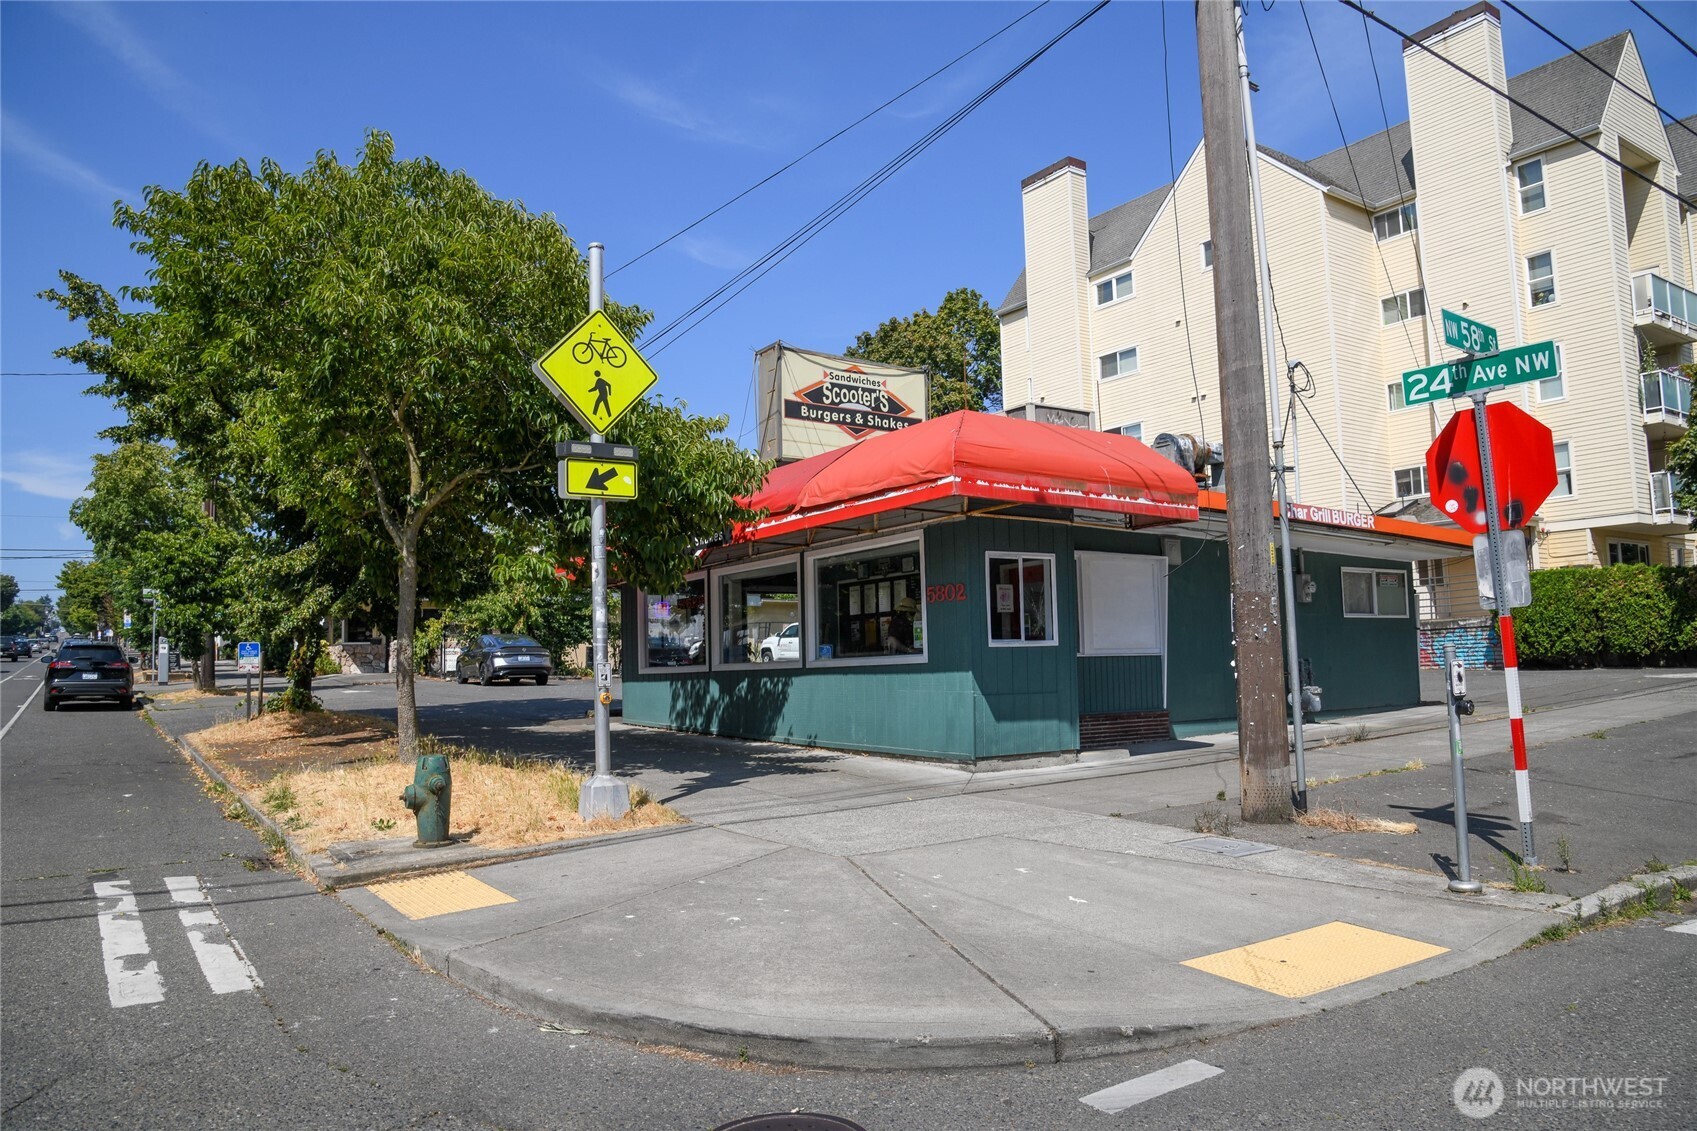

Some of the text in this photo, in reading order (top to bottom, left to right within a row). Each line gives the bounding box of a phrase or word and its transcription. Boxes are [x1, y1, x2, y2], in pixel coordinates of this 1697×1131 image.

[1445, 319, 1496, 351] NW 58th St
[828, 371, 881, 388] Sandwiches
[1407, 350, 1549, 401] 24th Ave NW
[801, 405, 909, 430] Burgers & Shakes
[1310, 507, 1332, 523] Grill
[1332, 509, 1375, 529] BURGER
[926, 583, 967, 604] 5802
